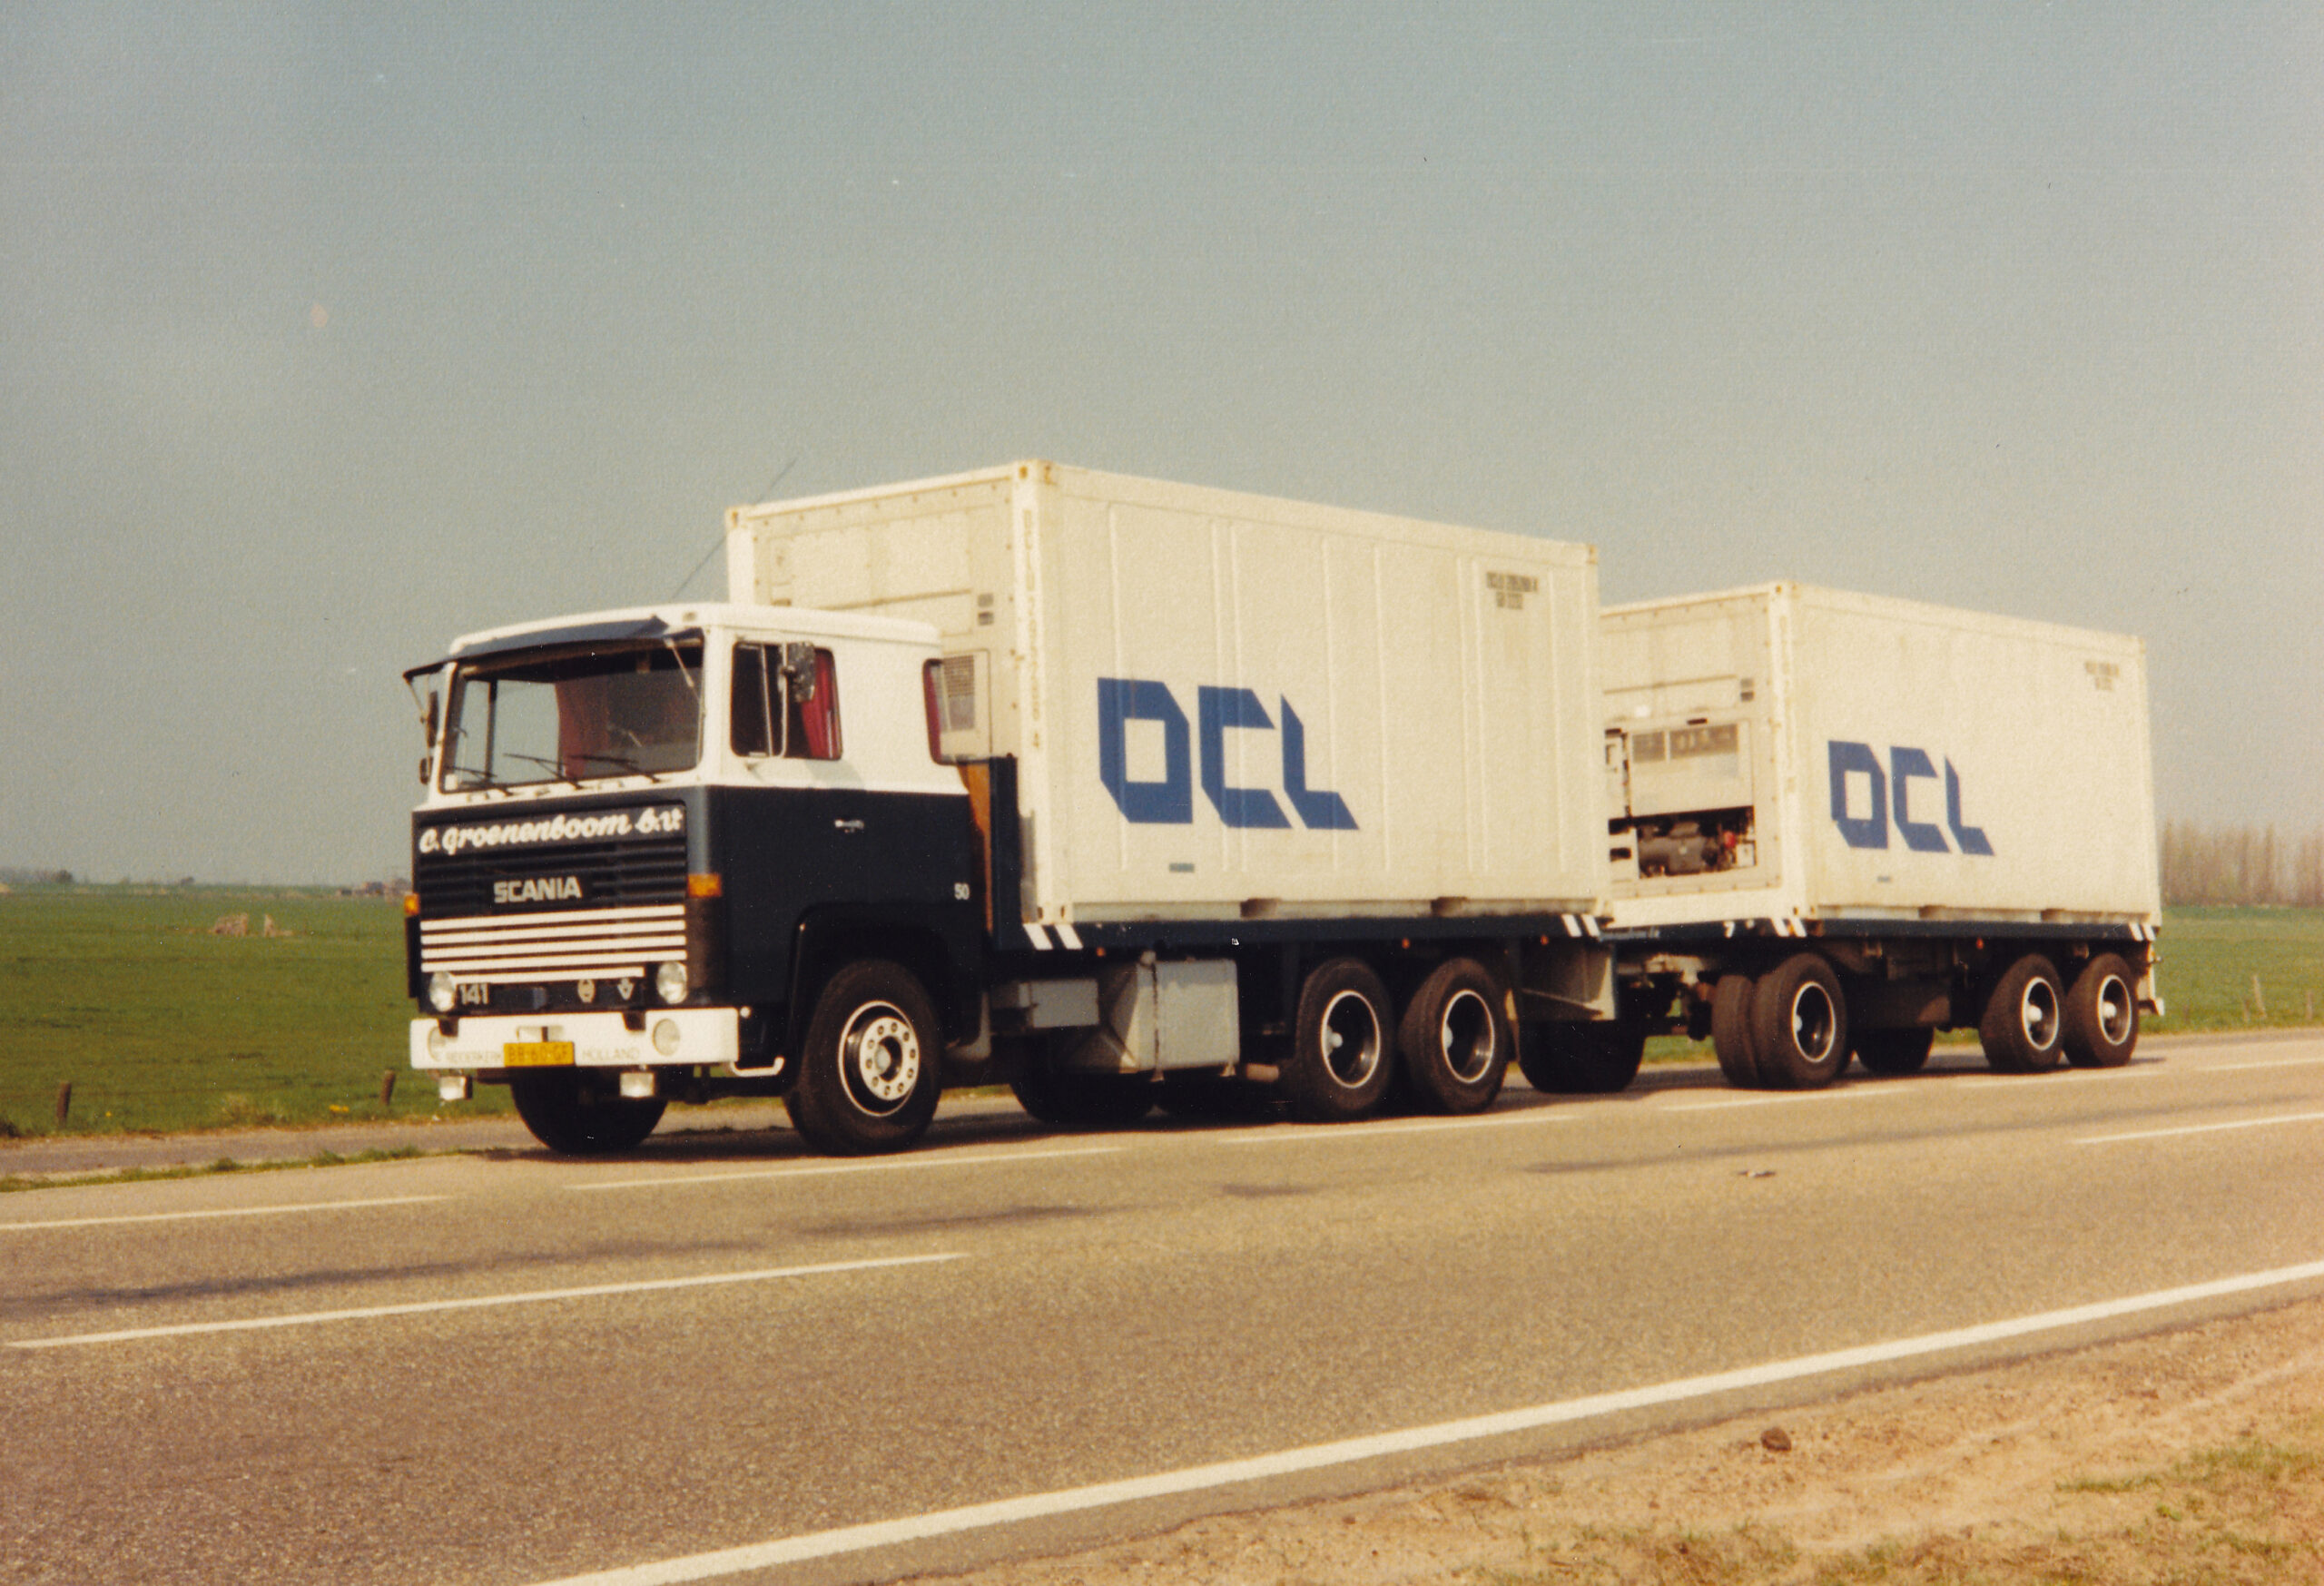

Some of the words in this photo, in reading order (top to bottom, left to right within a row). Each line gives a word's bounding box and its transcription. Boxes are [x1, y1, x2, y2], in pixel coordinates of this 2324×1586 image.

[1097, 676, 1360, 831] OCL
[1827, 740, 1995, 856] OCL
[441, 813, 633, 856] Groenenboom
[493, 875, 583, 903] SCANIA
[954, 882, 970, 901] 50
[459, 982, 488, 1005] 141
[582, 1046, 641, 1061] HOLLAND
